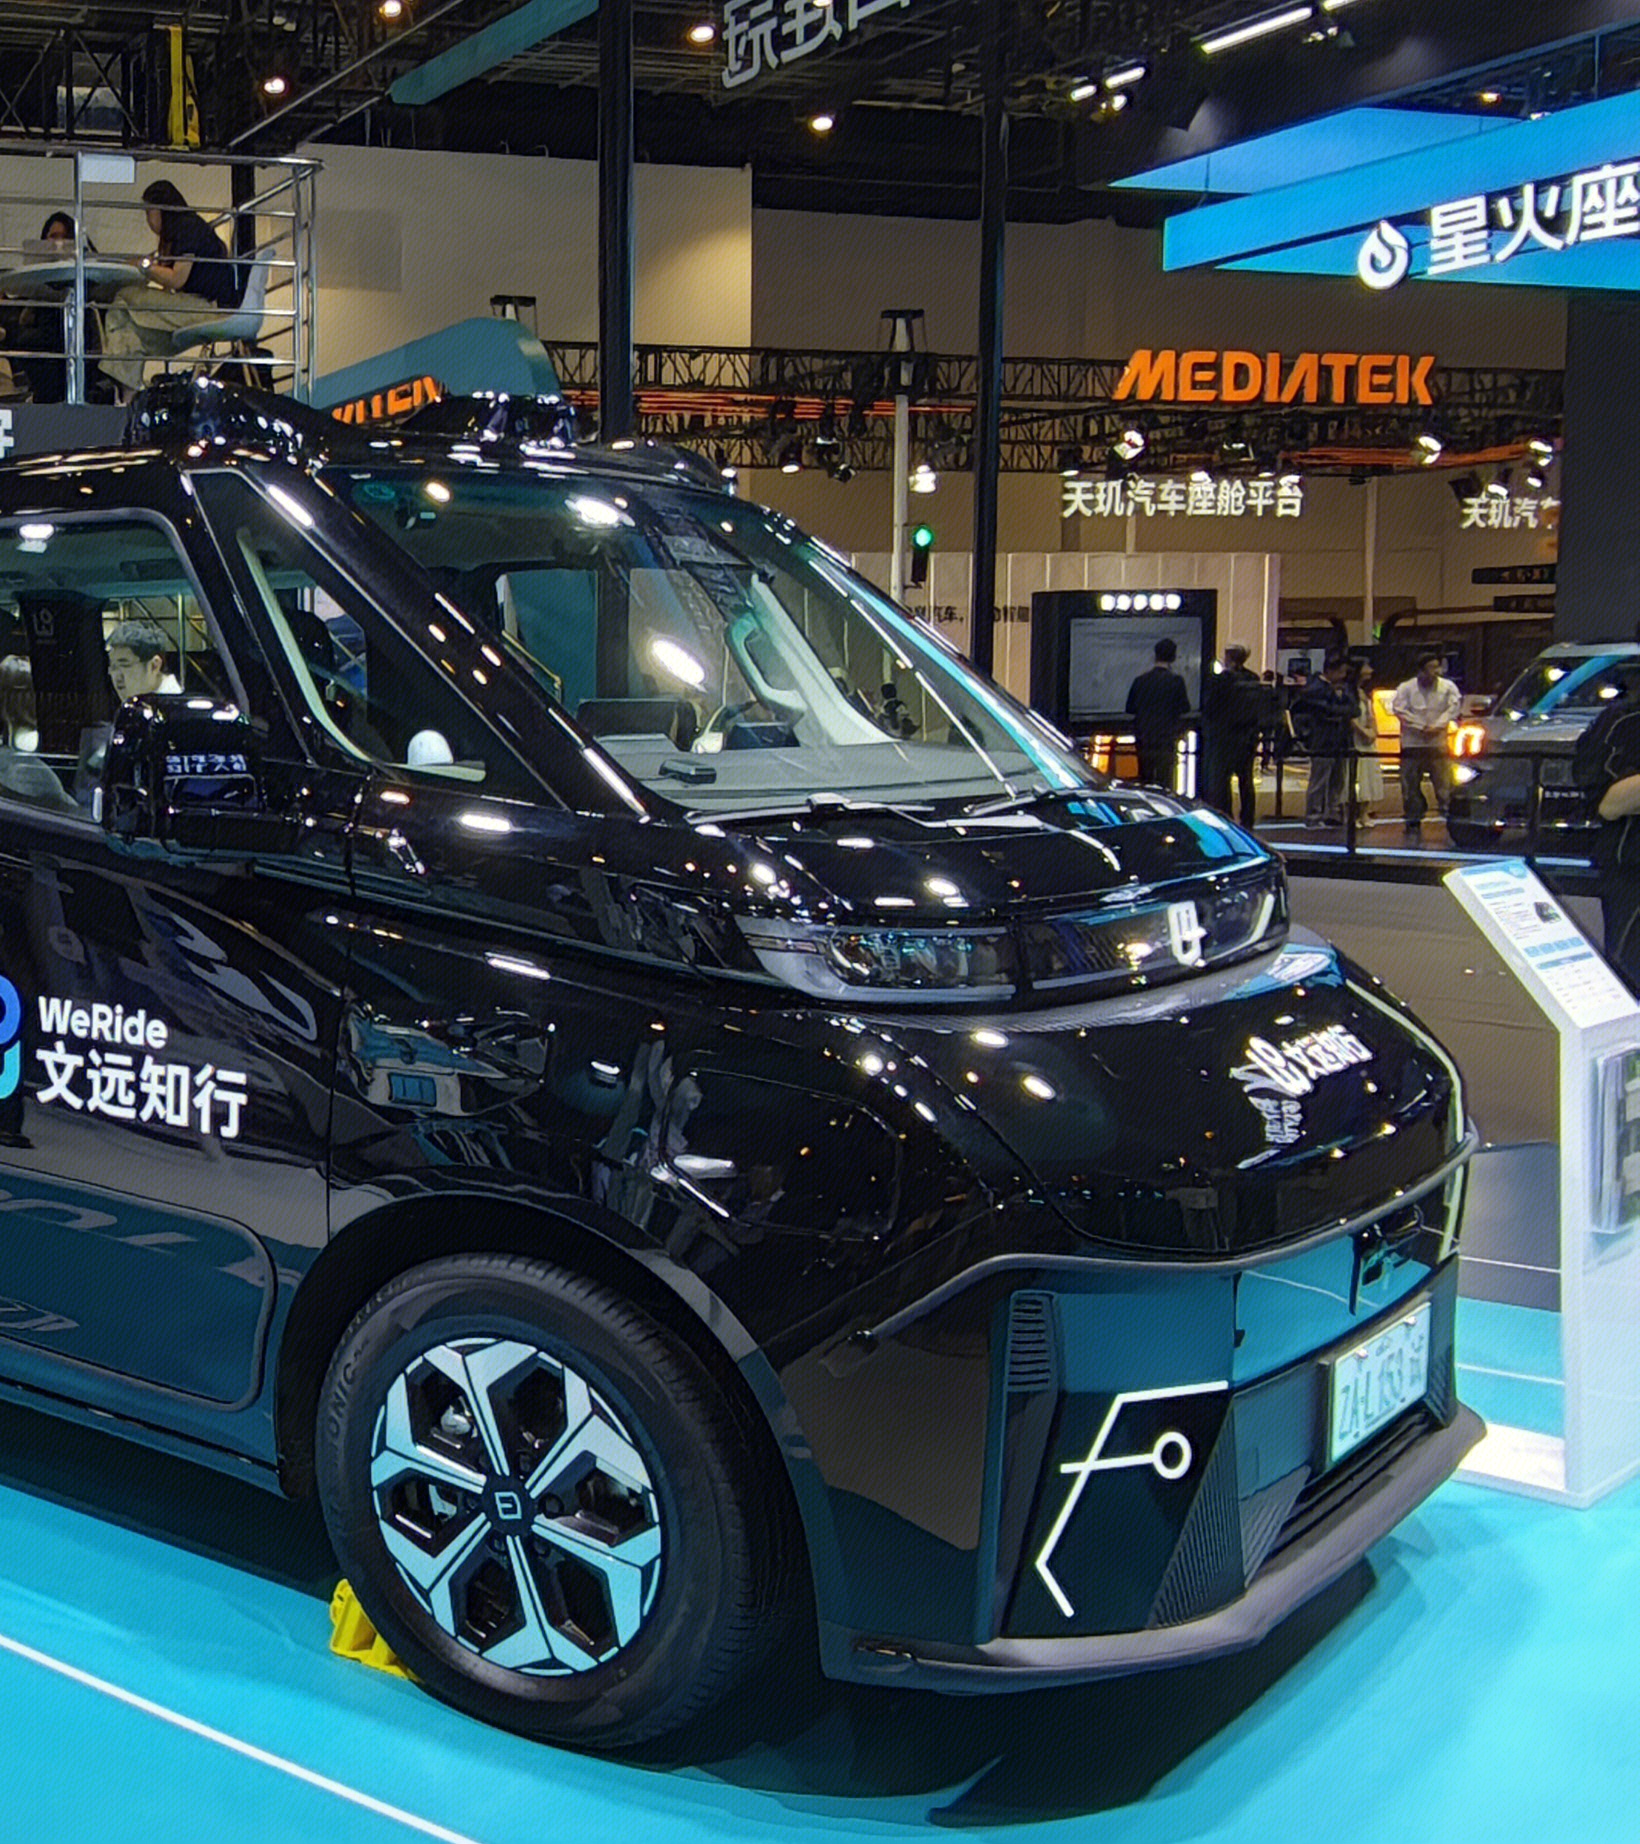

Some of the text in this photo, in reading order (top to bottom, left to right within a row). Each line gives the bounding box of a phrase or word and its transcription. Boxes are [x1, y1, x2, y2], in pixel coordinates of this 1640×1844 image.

[1427, 162, 1640, 276] 星火座
[1111, 349, 1436, 406] MEDIATEK
[1062, 479, 1304, 519] 天玑汽车座舱平台
[38, 995, 168, 1049] WeRide
[36, 1040, 248, 1139] 文远知行
